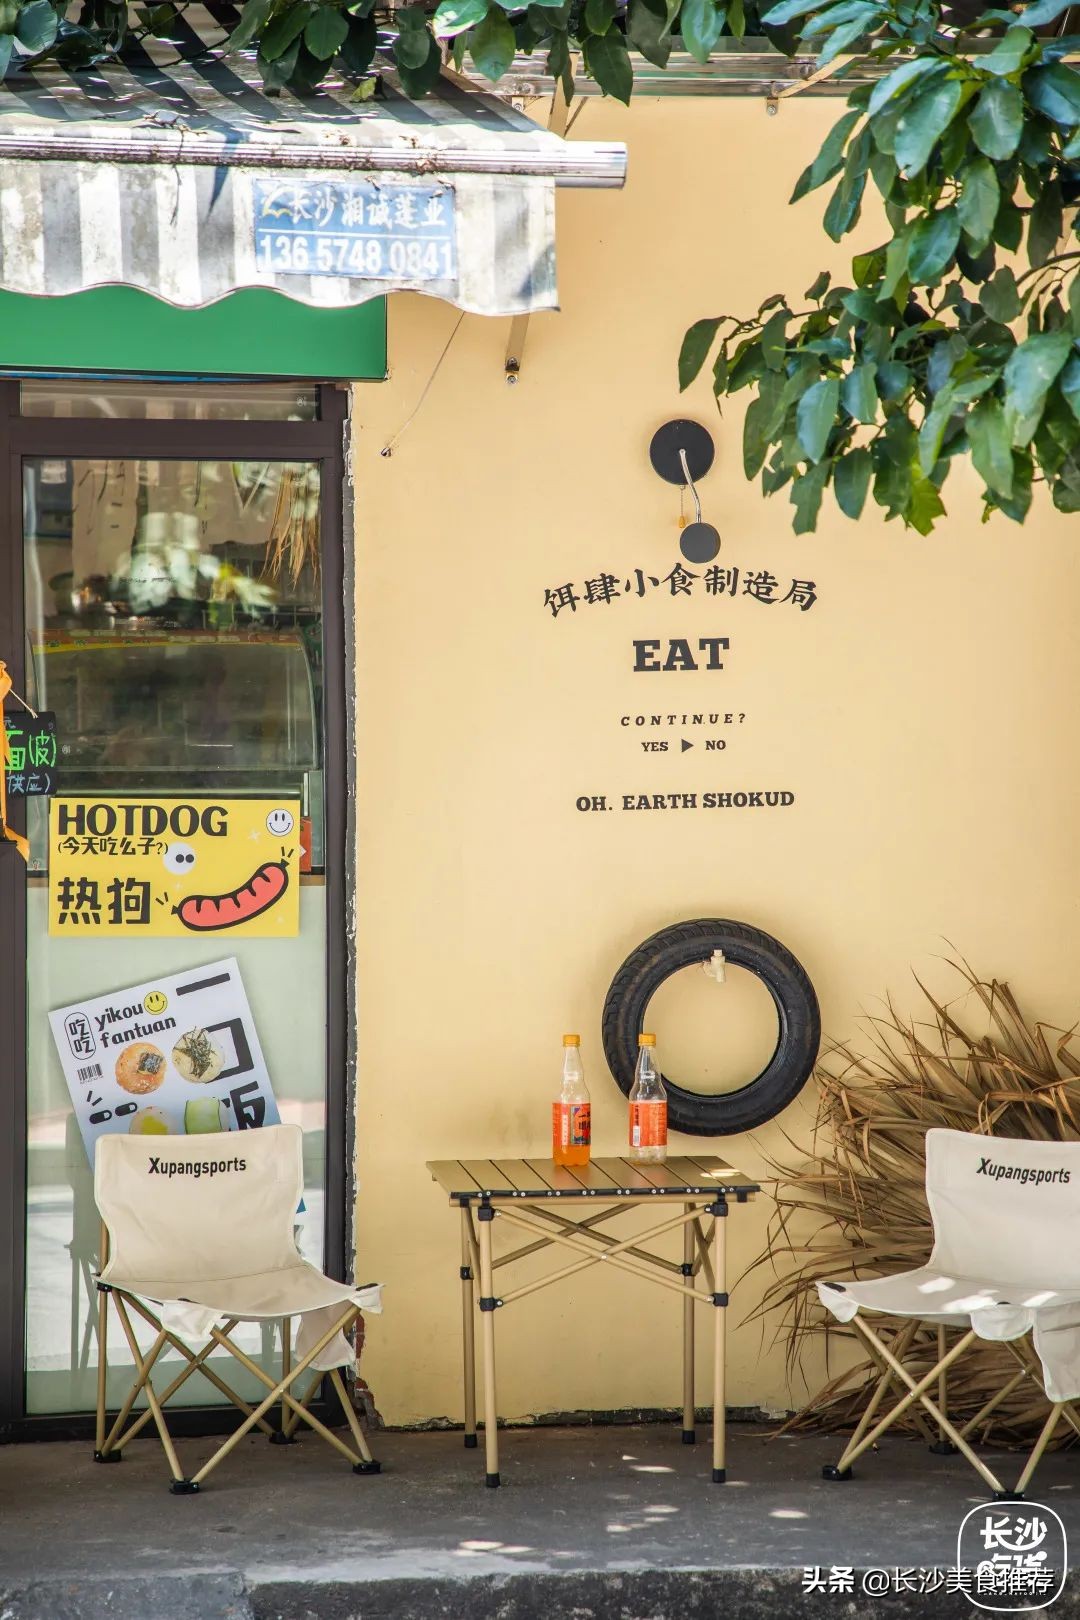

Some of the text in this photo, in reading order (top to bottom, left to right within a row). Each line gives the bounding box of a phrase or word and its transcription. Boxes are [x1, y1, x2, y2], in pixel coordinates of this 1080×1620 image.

[260, 234, 452, 275] 136 5748 0841
[543, 562, 818, 618] 饵肆小食制造局
[632, 637, 730, 672] EAT
[620, 713, 746, 727] CONTINUE?
[641, 739, 726, 752] YES NO
[576, 791, 795, 811] OH. EARTH SHOKUD
[58, 804, 229, 837] HOTDOG
[57, 876, 151, 925] 热狗
[94, 1003, 144, 1032] yikou
[100, 1016, 177, 1048] fantuan
[148, 1156, 247, 1178] Xupangsports
[976, 1157, 1071, 1186] Xupangsports
